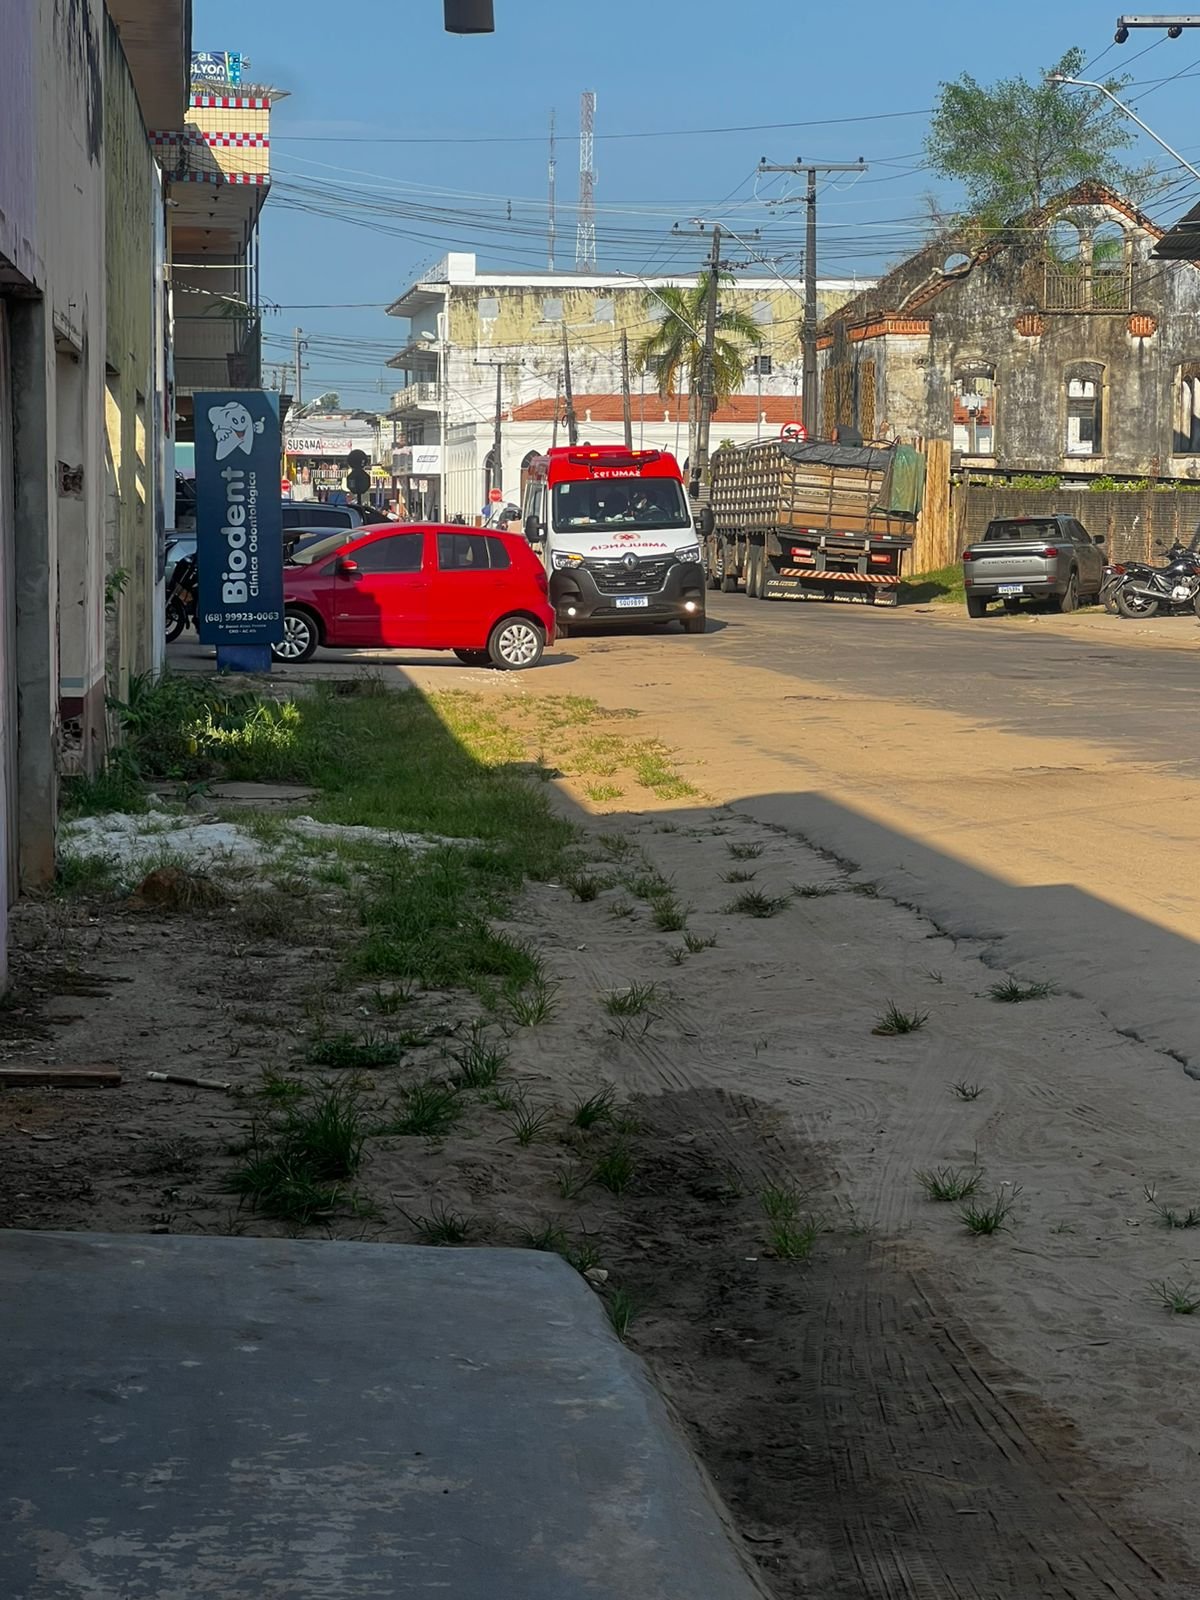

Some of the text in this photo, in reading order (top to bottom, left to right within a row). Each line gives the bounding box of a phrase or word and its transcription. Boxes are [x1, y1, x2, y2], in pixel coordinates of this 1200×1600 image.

[287, 439, 321, 450] SUSANA
[221, 466, 248, 604] Biodent
[247, 471, 259, 597] Clínica Odontológica
[205, 613, 223, 623] (68)
